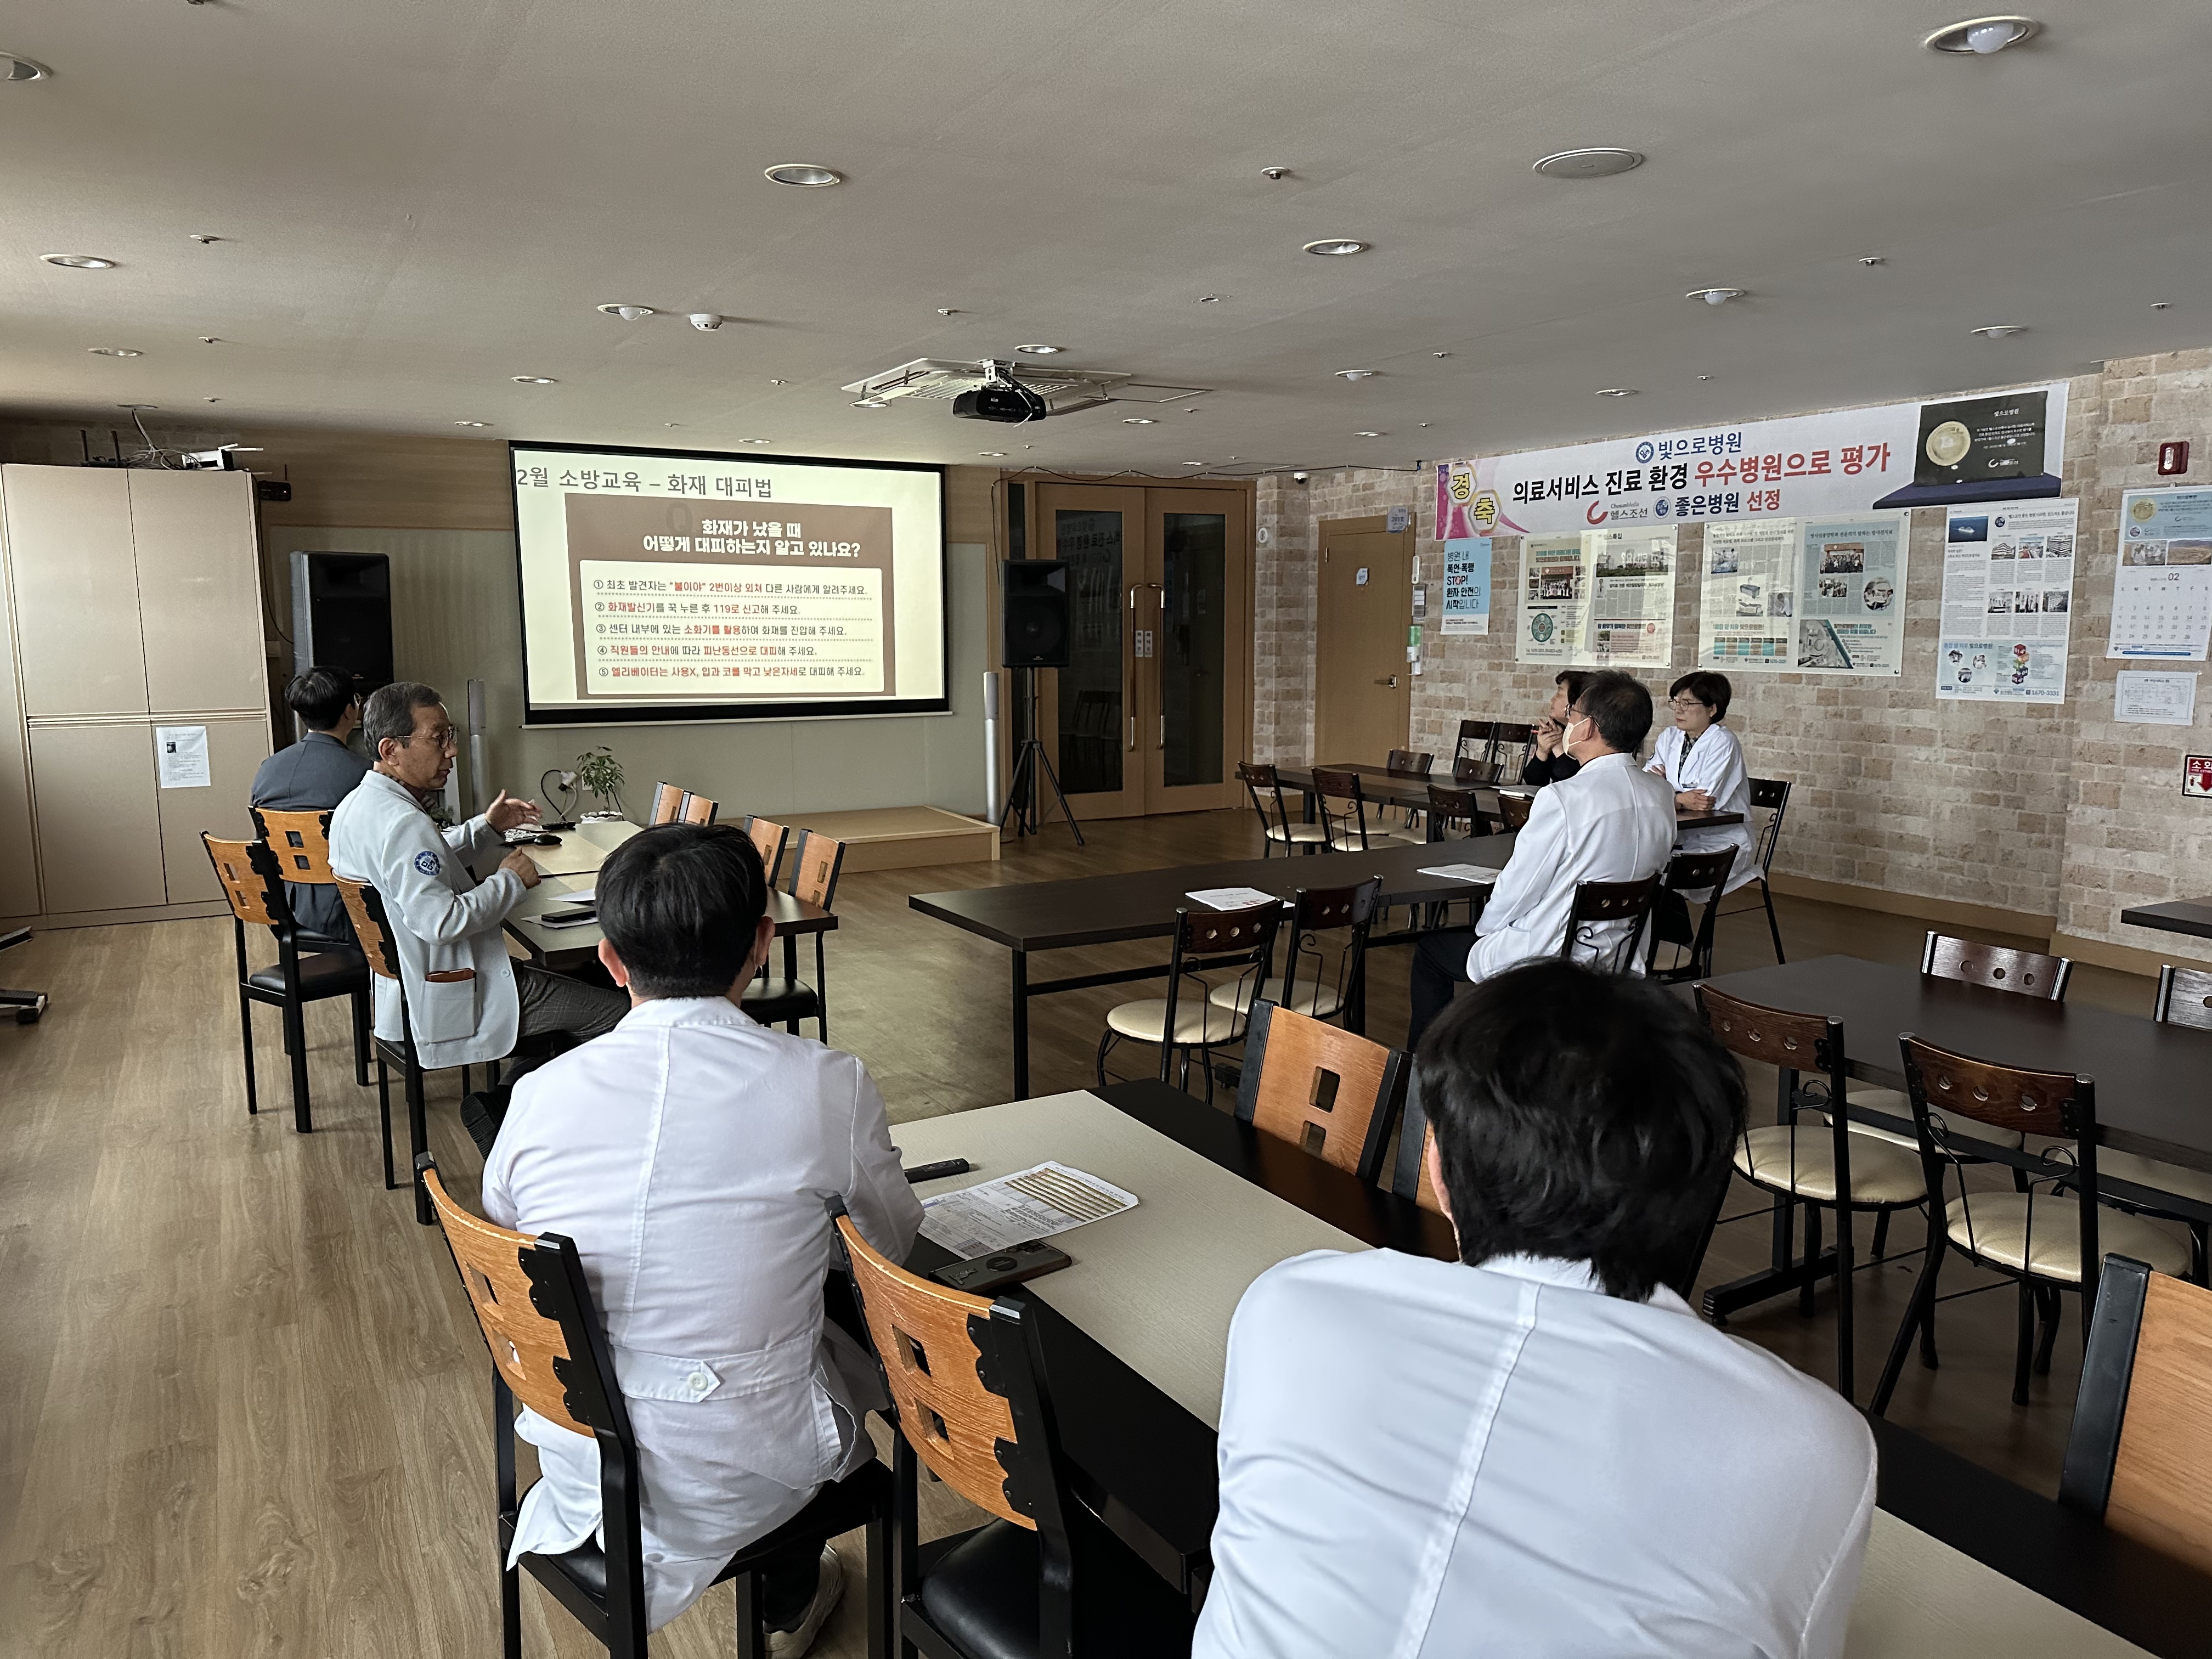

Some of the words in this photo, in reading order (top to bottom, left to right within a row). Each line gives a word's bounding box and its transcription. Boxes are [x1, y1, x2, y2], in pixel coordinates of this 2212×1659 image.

[1658, 432, 1742, 460] 빛으로병원
[1513, 474, 1599, 505] 의료서비스
[1605, 469, 1641, 495] 진료
[1648, 462, 1688, 492] 환경
[1695, 449, 1831, 488] 우수병원으로
[1841, 442, 1891, 475] 평가
[517, 467, 549, 487] 2월
[560, 470, 641, 493] 소방교육
[668, 473, 706, 495] 화재
[716, 477, 771, 498] 대피법
[1451, 473, 1470, 499] 경
[1474, 498, 1496, 524] 축
[1610, 507, 1647, 520] 헬스조선
[1675, 492, 1740, 517] 좋은병원
[1747, 489, 1780, 512] 선정
[701, 519, 748, 537] 화재가
[752, 520, 782, 538] 났을
[786, 522, 802, 539] 때
[643, 534, 690, 554] 어떻게
[695, 537, 770, 555] 대피하는지
[775, 539, 804, 556] 알고
[808, 540, 861, 557] 있나요?
[1447, 551, 1460, 562] 병원
[1462, 550, 1469, 561] 내
[1447, 575, 1468, 585] STOP!
[2168, 573, 2180, 581] 02
[607, 580, 625, 590] 최초
[629, 580, 666, 591] 발견자는
[709, 582, 742, 593] 2번이상
[745, 583, 762, 593] 외쳐
[765, 584, 782, 594] 다른
[786, 584, 820, 594] 사람에게
[823, 585, 868, 595] 알려주세요.
[1447, 588, 1459, 597] 환자
[1461, 586, 1481, 597] 안전의
[608, 602, 664, 613] 화재발신기를
[668, 603, 676, 613] 꾹
[680, 603, 698, 613] 누른
[702, 603, 710, 613] 후
[714, 604, 740, 614] 119로
[742, 605, 769, 614] 신고해
[772, 605, 800, 615] 주세요.
[1446, 599, 1479, 610] 시작입니다
[609, 624, 628, 634] 센터
[631, 624, 659, 634] 내부에
[663, 624, 681, 635] 있는
[684, 624, 720, 635] 소화기를
[724, 625, 759, 635] 활용하여
[762, 625, 787, 635] 화재를
[791, 625, 816, 636] 진압해
[819, 626, 847, 636] 주세요.
[610, 645, 648, 656] 직원들의
[651, 646, 679, 656] 안내에
[682, 646, 701, 656] 따라
[704, 646, 757, 656] 피난동선으로
[760, 646, 786, 656] 대피해
[789, 646, 817, 656] 주세요.
[612, 667, 668, 677] 엘리베이터는
[702, 667, 720, 677] 입과
[723, 667, 740, 676] 코를
[743, 667, 761, 676] 막고
[764, 667, 806, 676] 낮은자세로
[809, 667, 834, 676] 대피해
[837, 667, 865, 676] 주세요.
